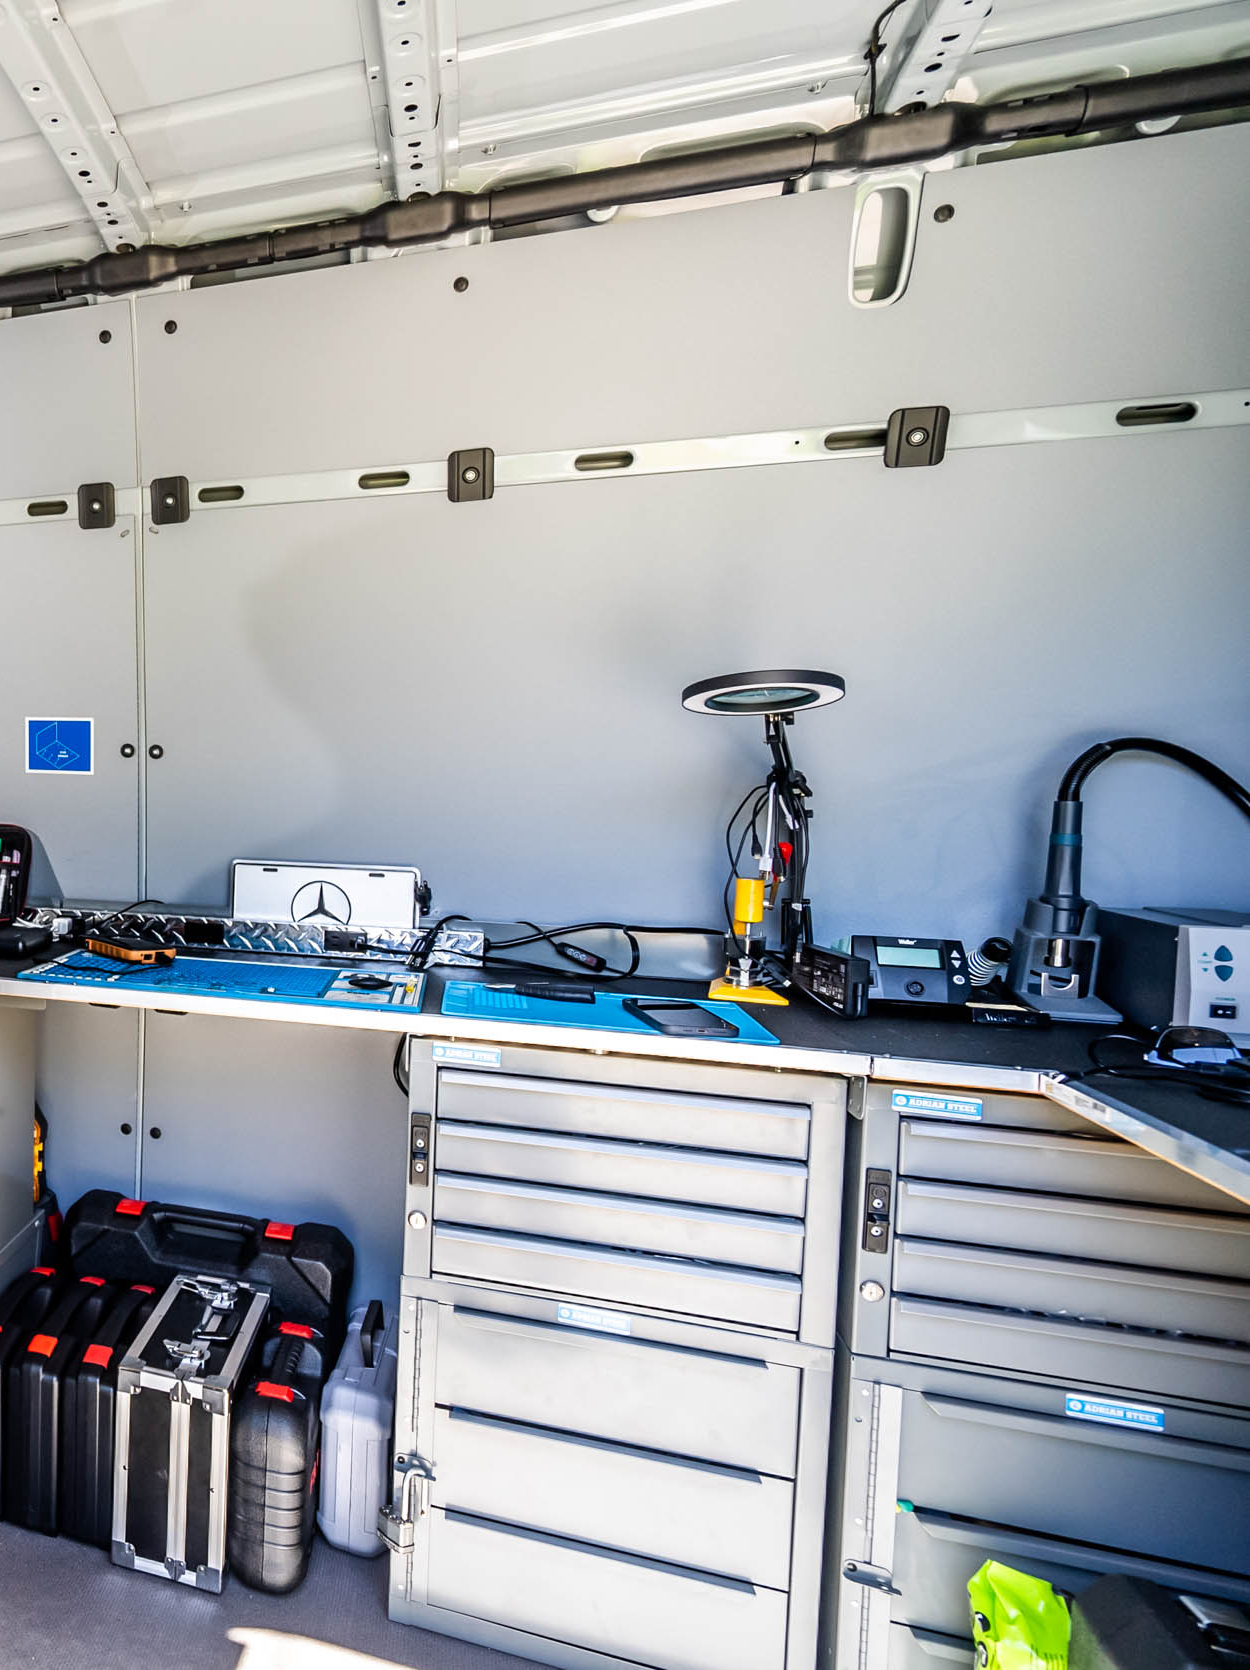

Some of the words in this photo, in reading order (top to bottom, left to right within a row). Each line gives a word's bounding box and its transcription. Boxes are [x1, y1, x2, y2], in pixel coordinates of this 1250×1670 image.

[908, 1098, 946, 1109] ADRIAN
[947, 1103, 977, 1113] STEEL
[1083, 1403, 1124, 1417] ADRIAN
[1126, 1411, 1159, 1424] STEEL
